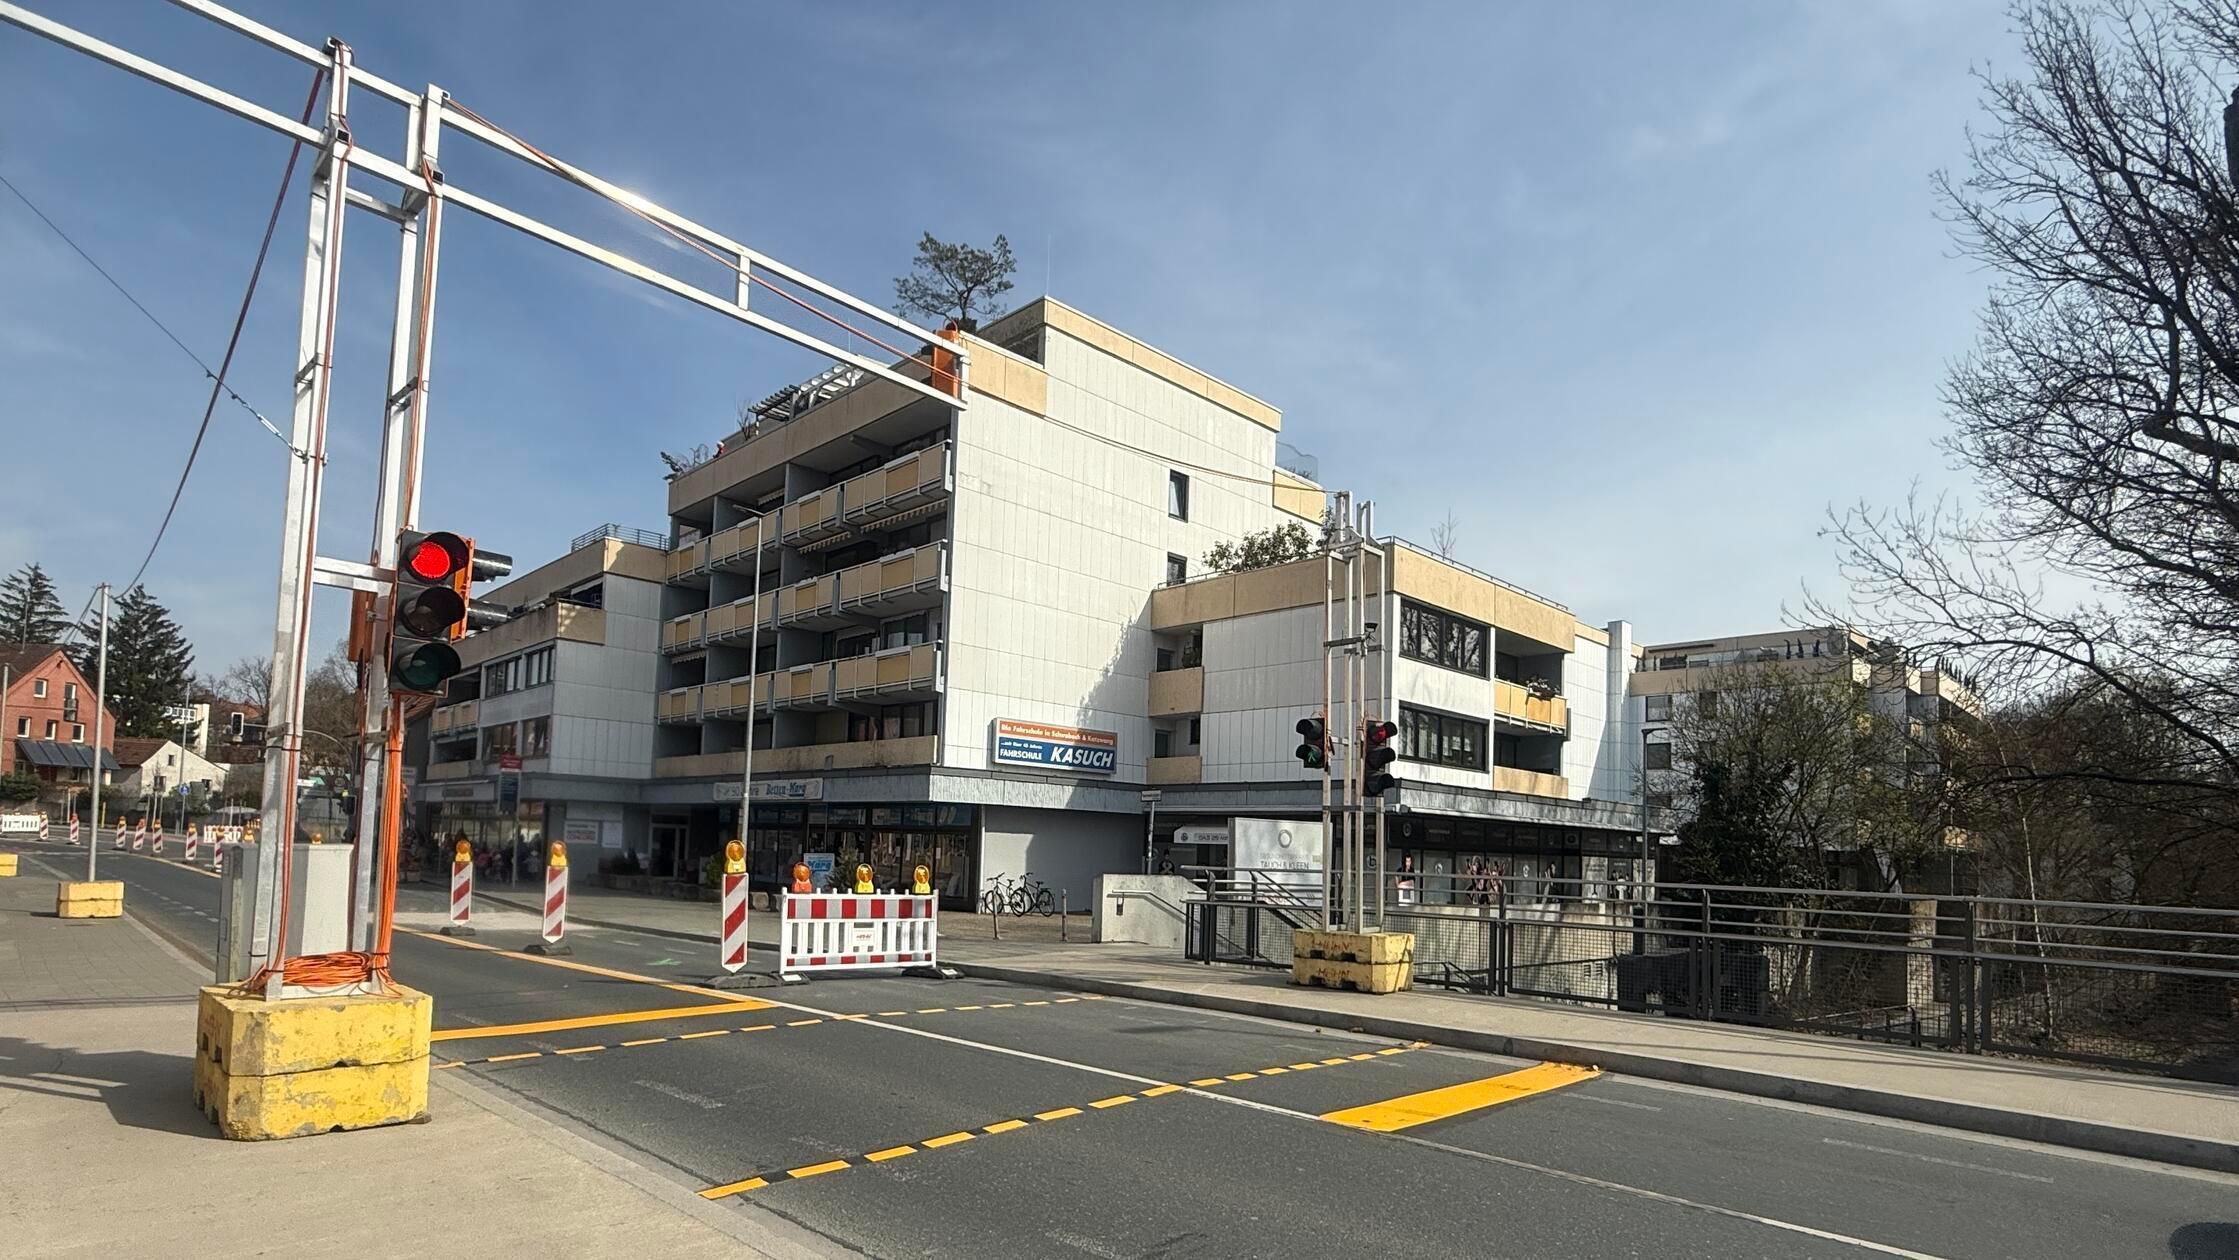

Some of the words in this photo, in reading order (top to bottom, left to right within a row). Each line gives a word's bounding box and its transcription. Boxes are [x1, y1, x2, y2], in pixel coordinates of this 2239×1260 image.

[1013, 725, 1043, 735] Fahrschule
[1000, 748, 1042, 760] FAHRSCHULE
[1050, 746, 1114, 768] KASUCH
